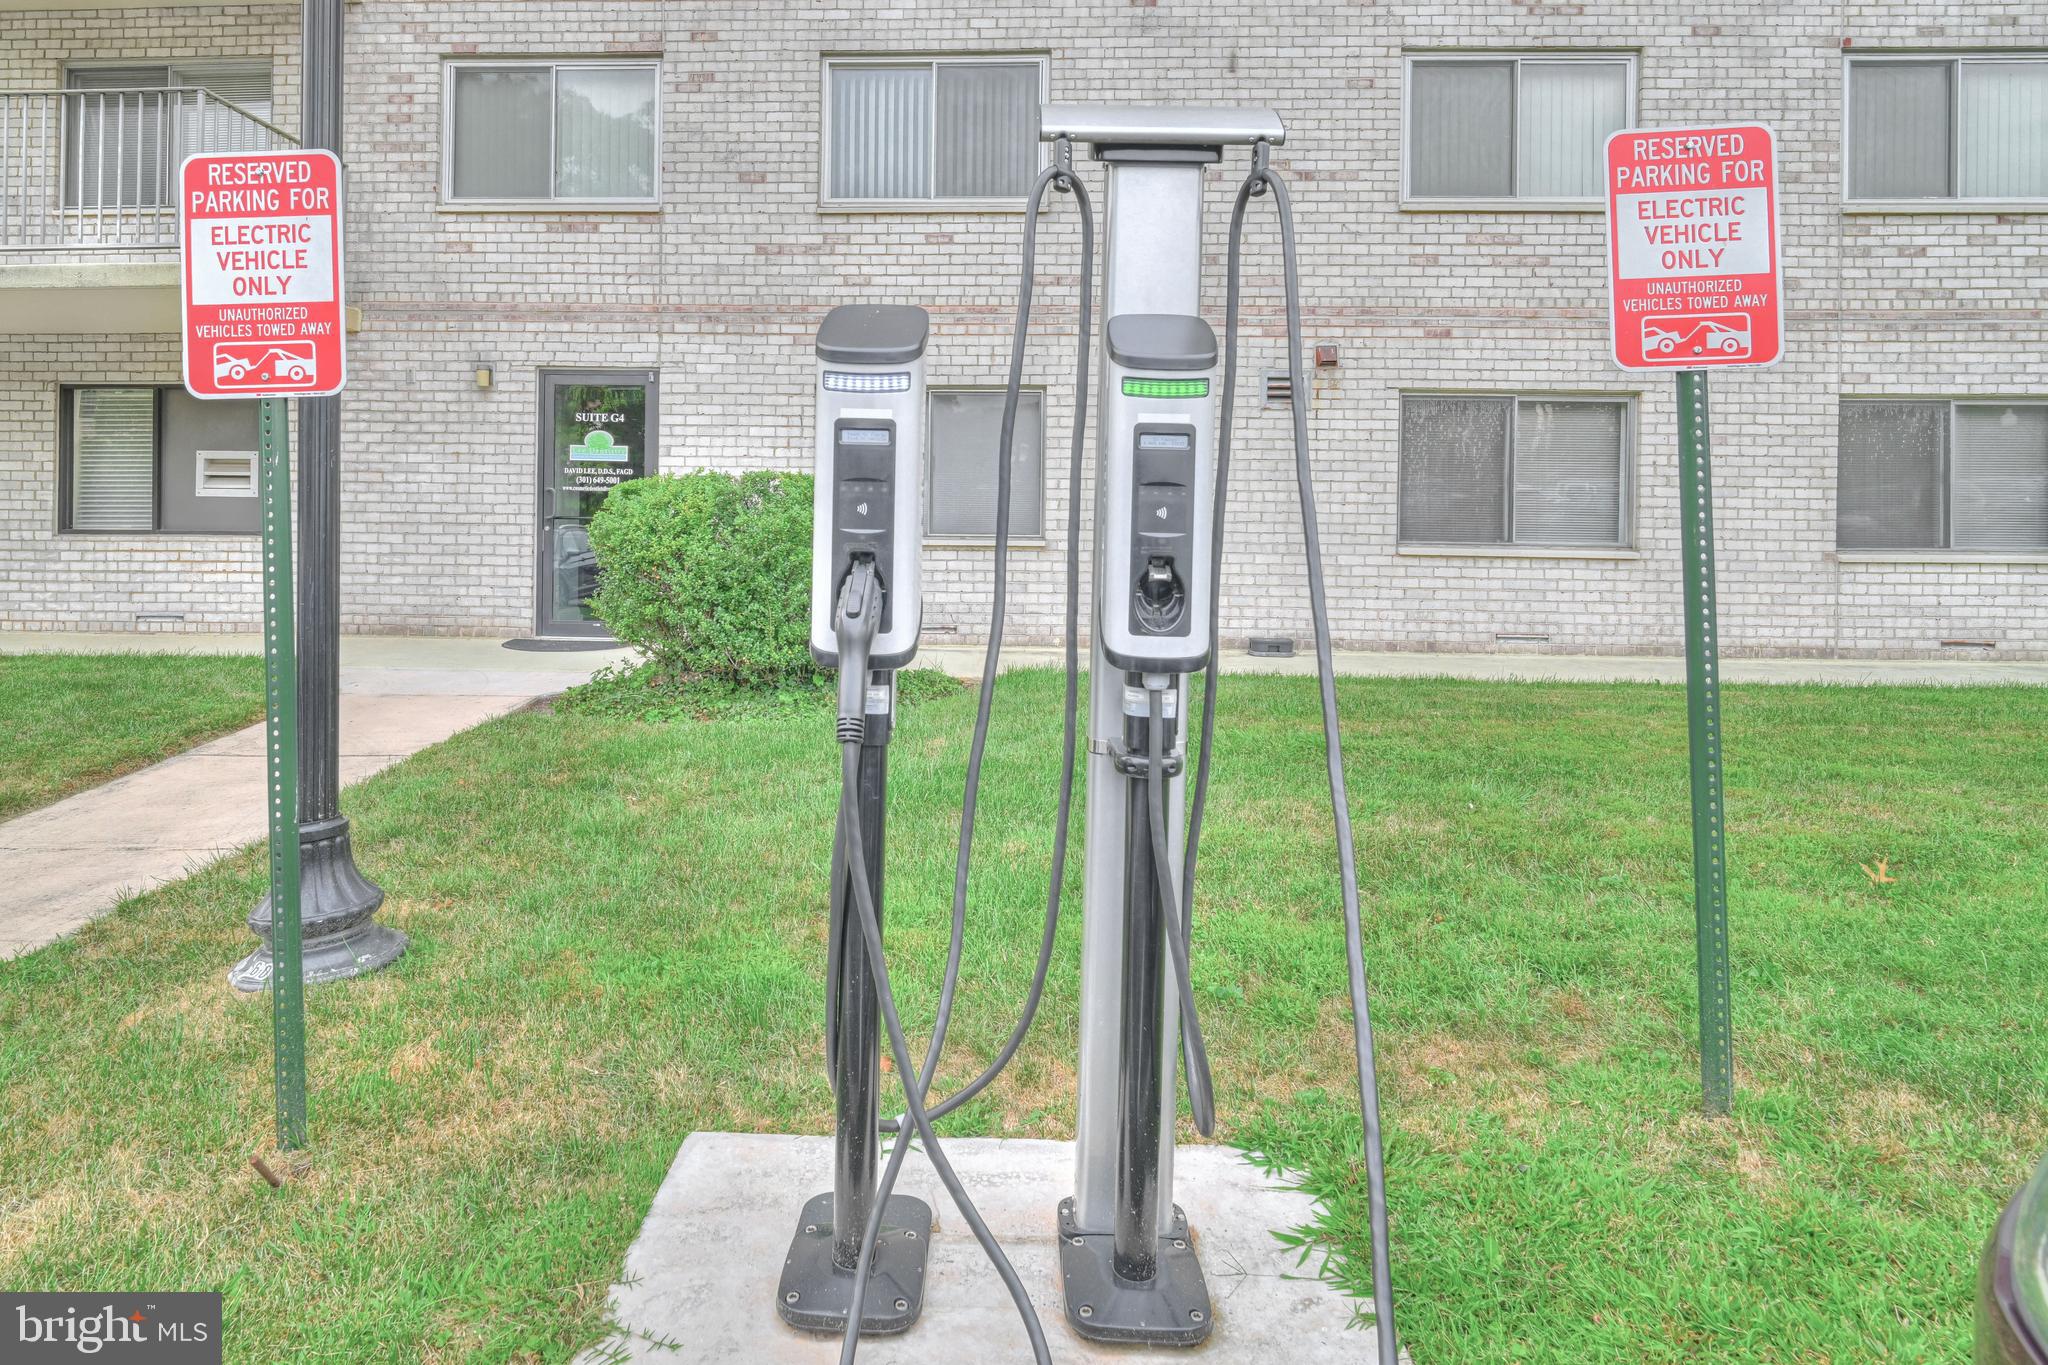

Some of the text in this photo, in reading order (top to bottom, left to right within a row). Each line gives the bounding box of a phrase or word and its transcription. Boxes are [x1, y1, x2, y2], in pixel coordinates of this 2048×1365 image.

[1634, 134, 1744, 160] RESERVED
[209, 161, 310, 185] RESERVED
[1617, 160, 1764, 187] PARKING FOR
[192, 188, 328, 212] PARKING FOR
[1638, 196, 1744, 219] ELECTRIC
[212, 224, 311, 245] ELECTRIC
[1644, 222, 1741, 244] VEHICLE
[217, 249, 307, 271] VEHICLE
[1662, 248, 1724, 269] ONLY
[233, 276, 291, 296] ONLY
[1648, 279, 1741, 294] UNAUTHORIZED
[1623, 294, 1767, 311] VEHICLES TOWED AWAY
[220, 307, 307, 321] UNAUTHORIZED
[196, 323, 331, 337] VEHICLES TOWED AWAY
[575, 413, 625, 422] SUITE G4
[576, 476, 592, 484] (301)
